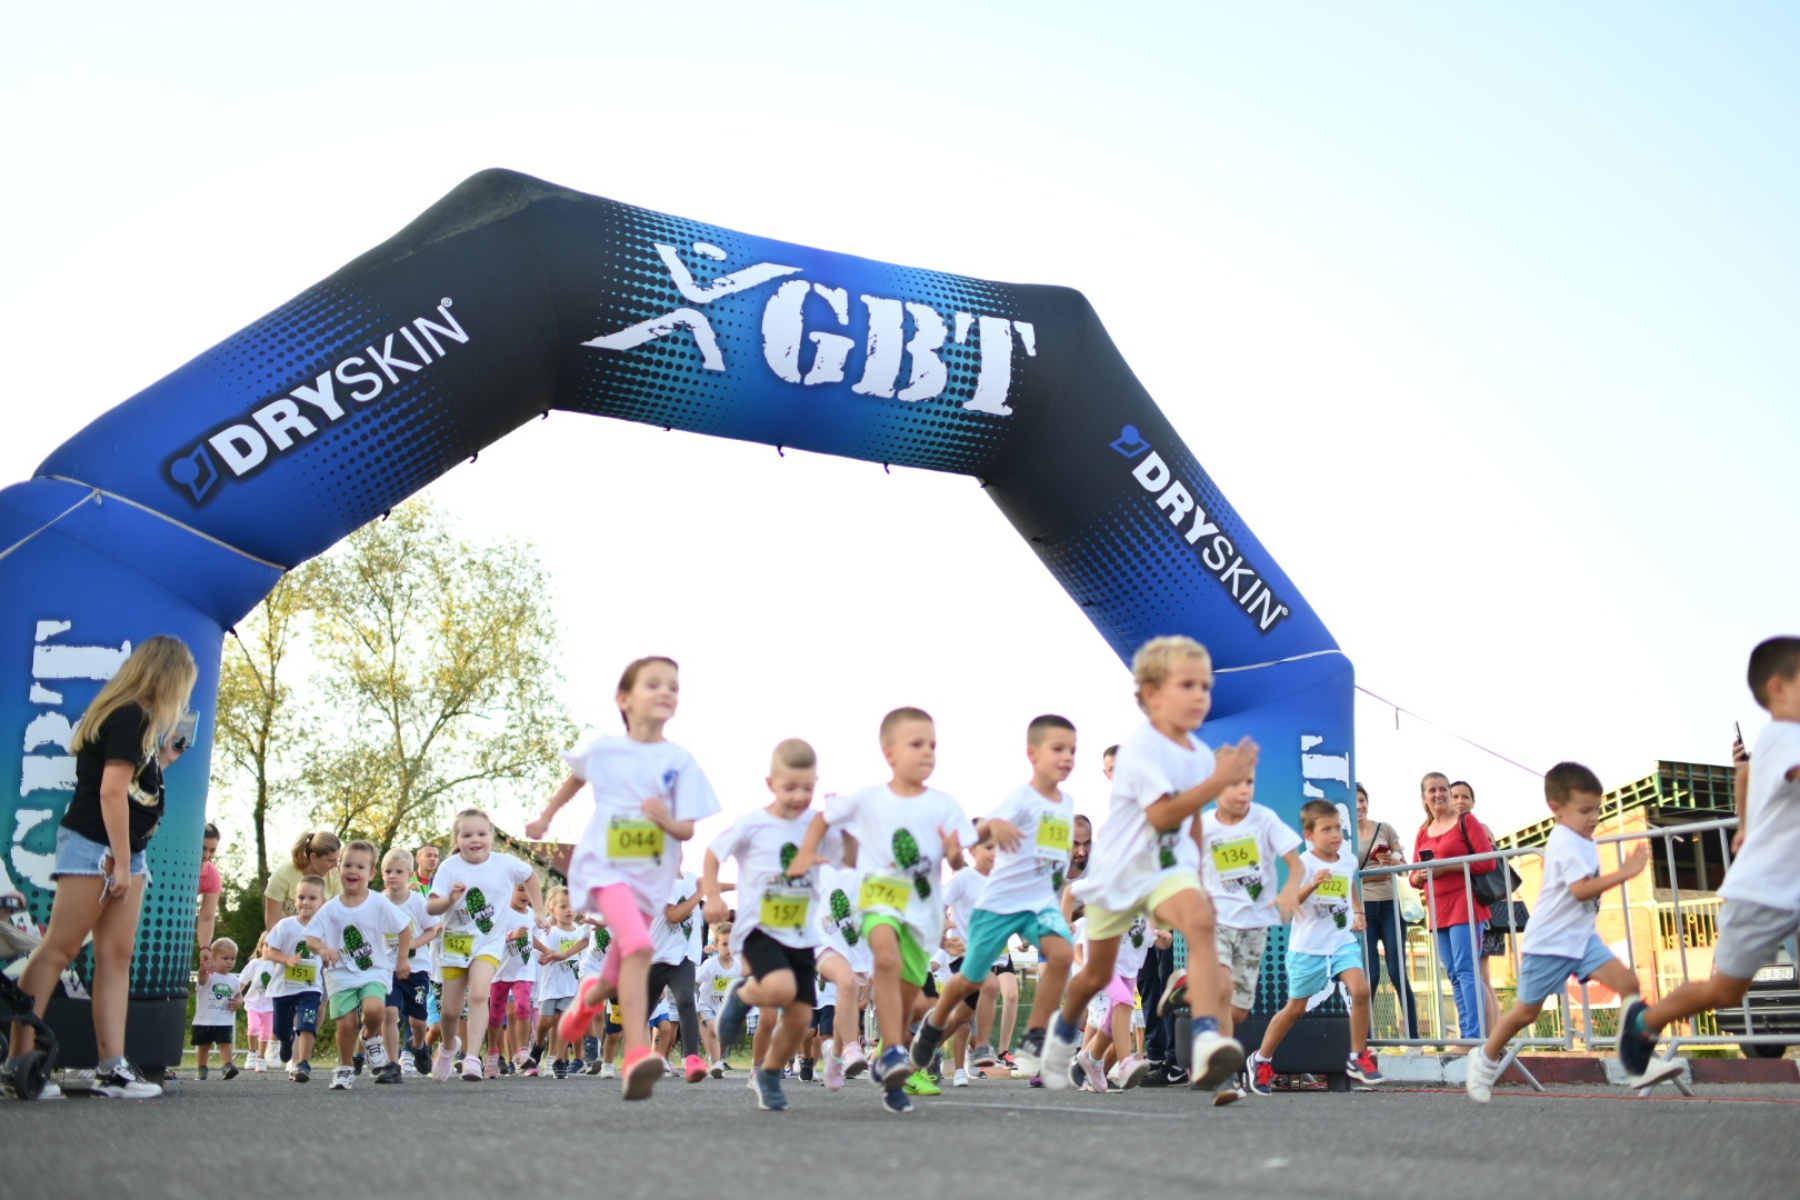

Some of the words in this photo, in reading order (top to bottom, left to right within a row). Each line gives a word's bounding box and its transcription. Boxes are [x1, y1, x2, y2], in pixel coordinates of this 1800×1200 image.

[762, 279, 1037, 416] GBT
[619, 830, 655, 849] 044
[1221, 846, 1248, 863] 136
[1323, 880, 1342, 891] 022
[773, 905, 799, 920] 157
[448, 938, 465, 951] 012
[291, 968, 308, 978] 151
